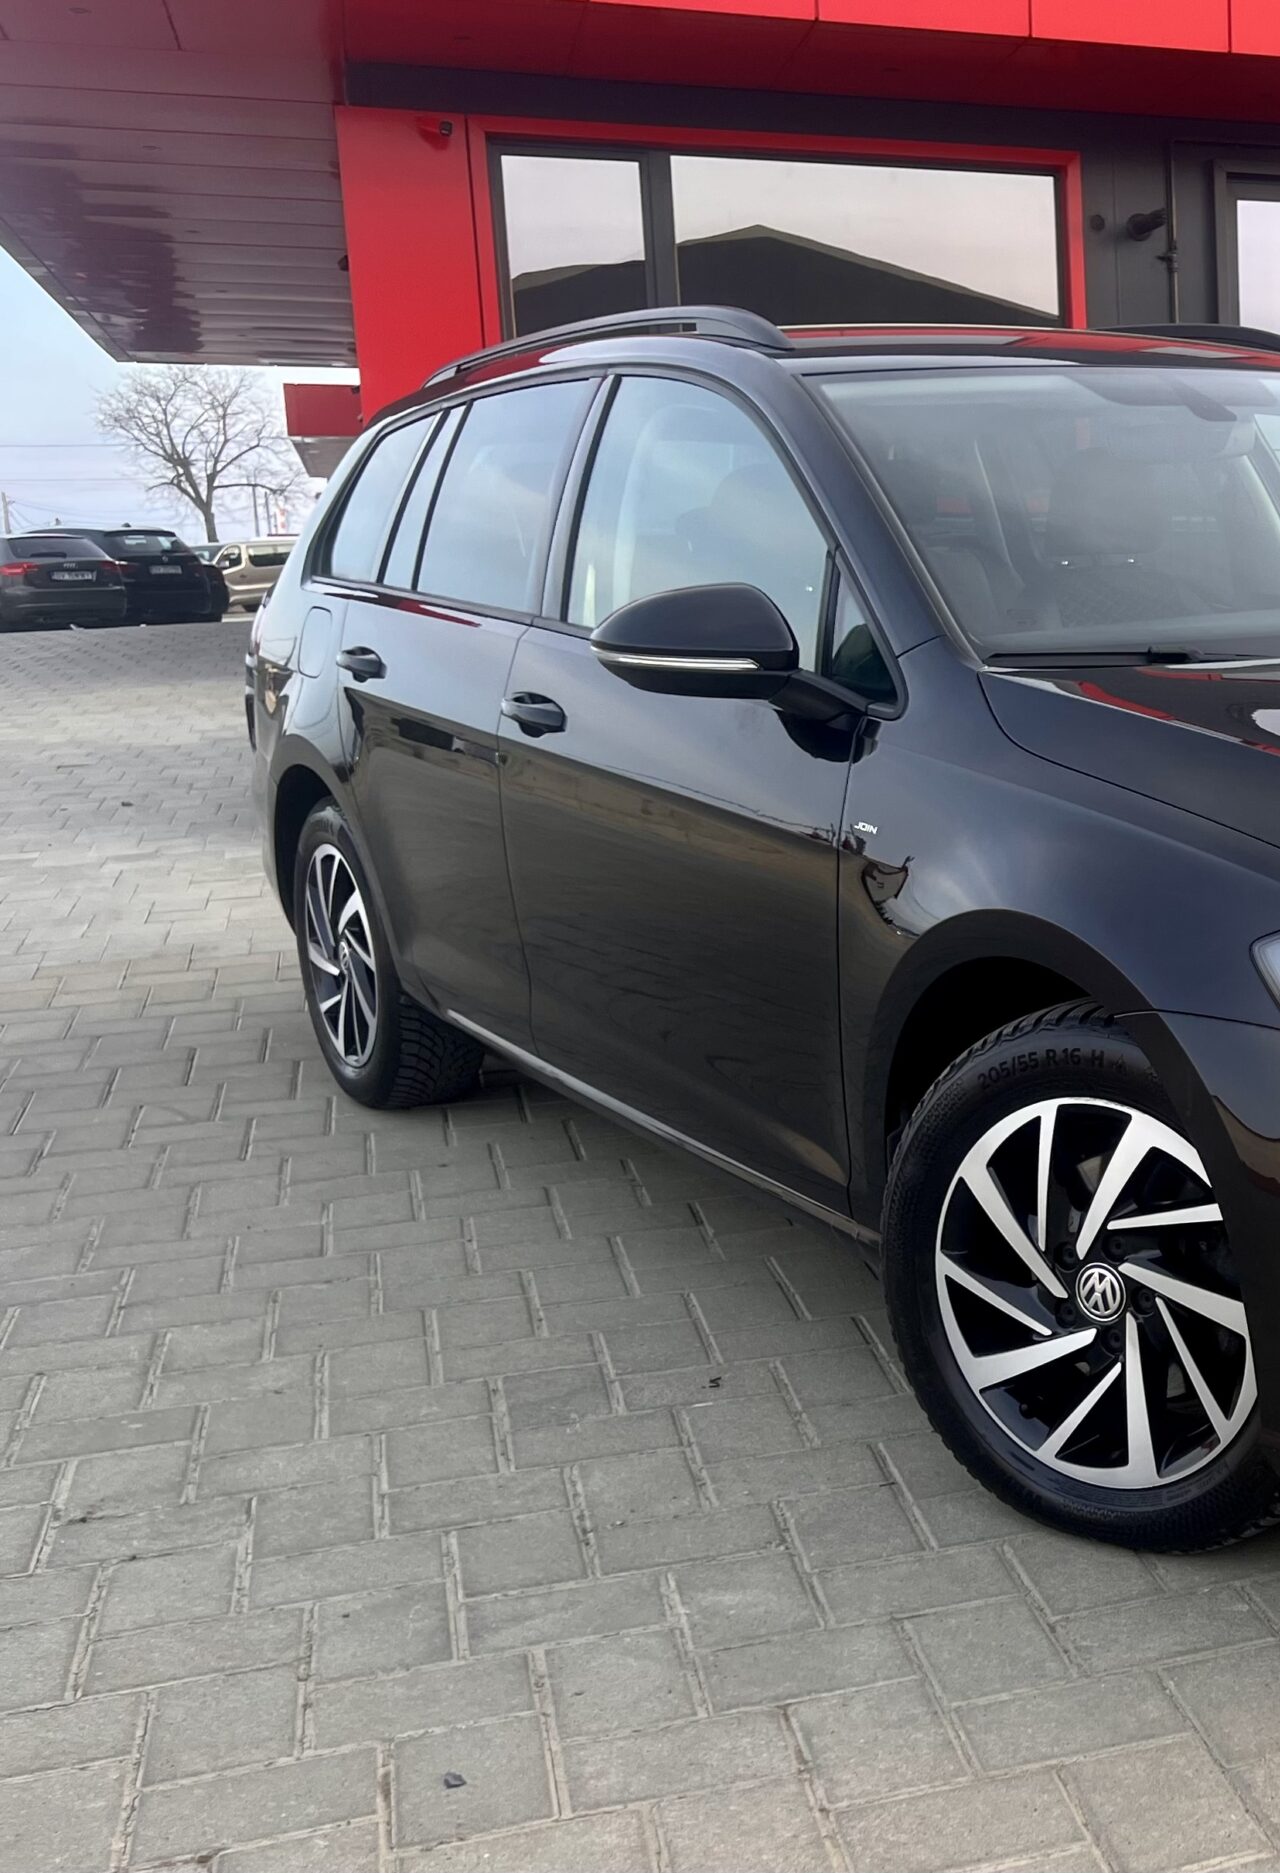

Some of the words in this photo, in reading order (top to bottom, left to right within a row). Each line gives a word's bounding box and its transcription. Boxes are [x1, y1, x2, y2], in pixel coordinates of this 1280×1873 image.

[854, 821, 878, 835] JOIN
[977, 1051, 1040, 1090] 205/55
[1091, 1050, 1105, 1069] H
